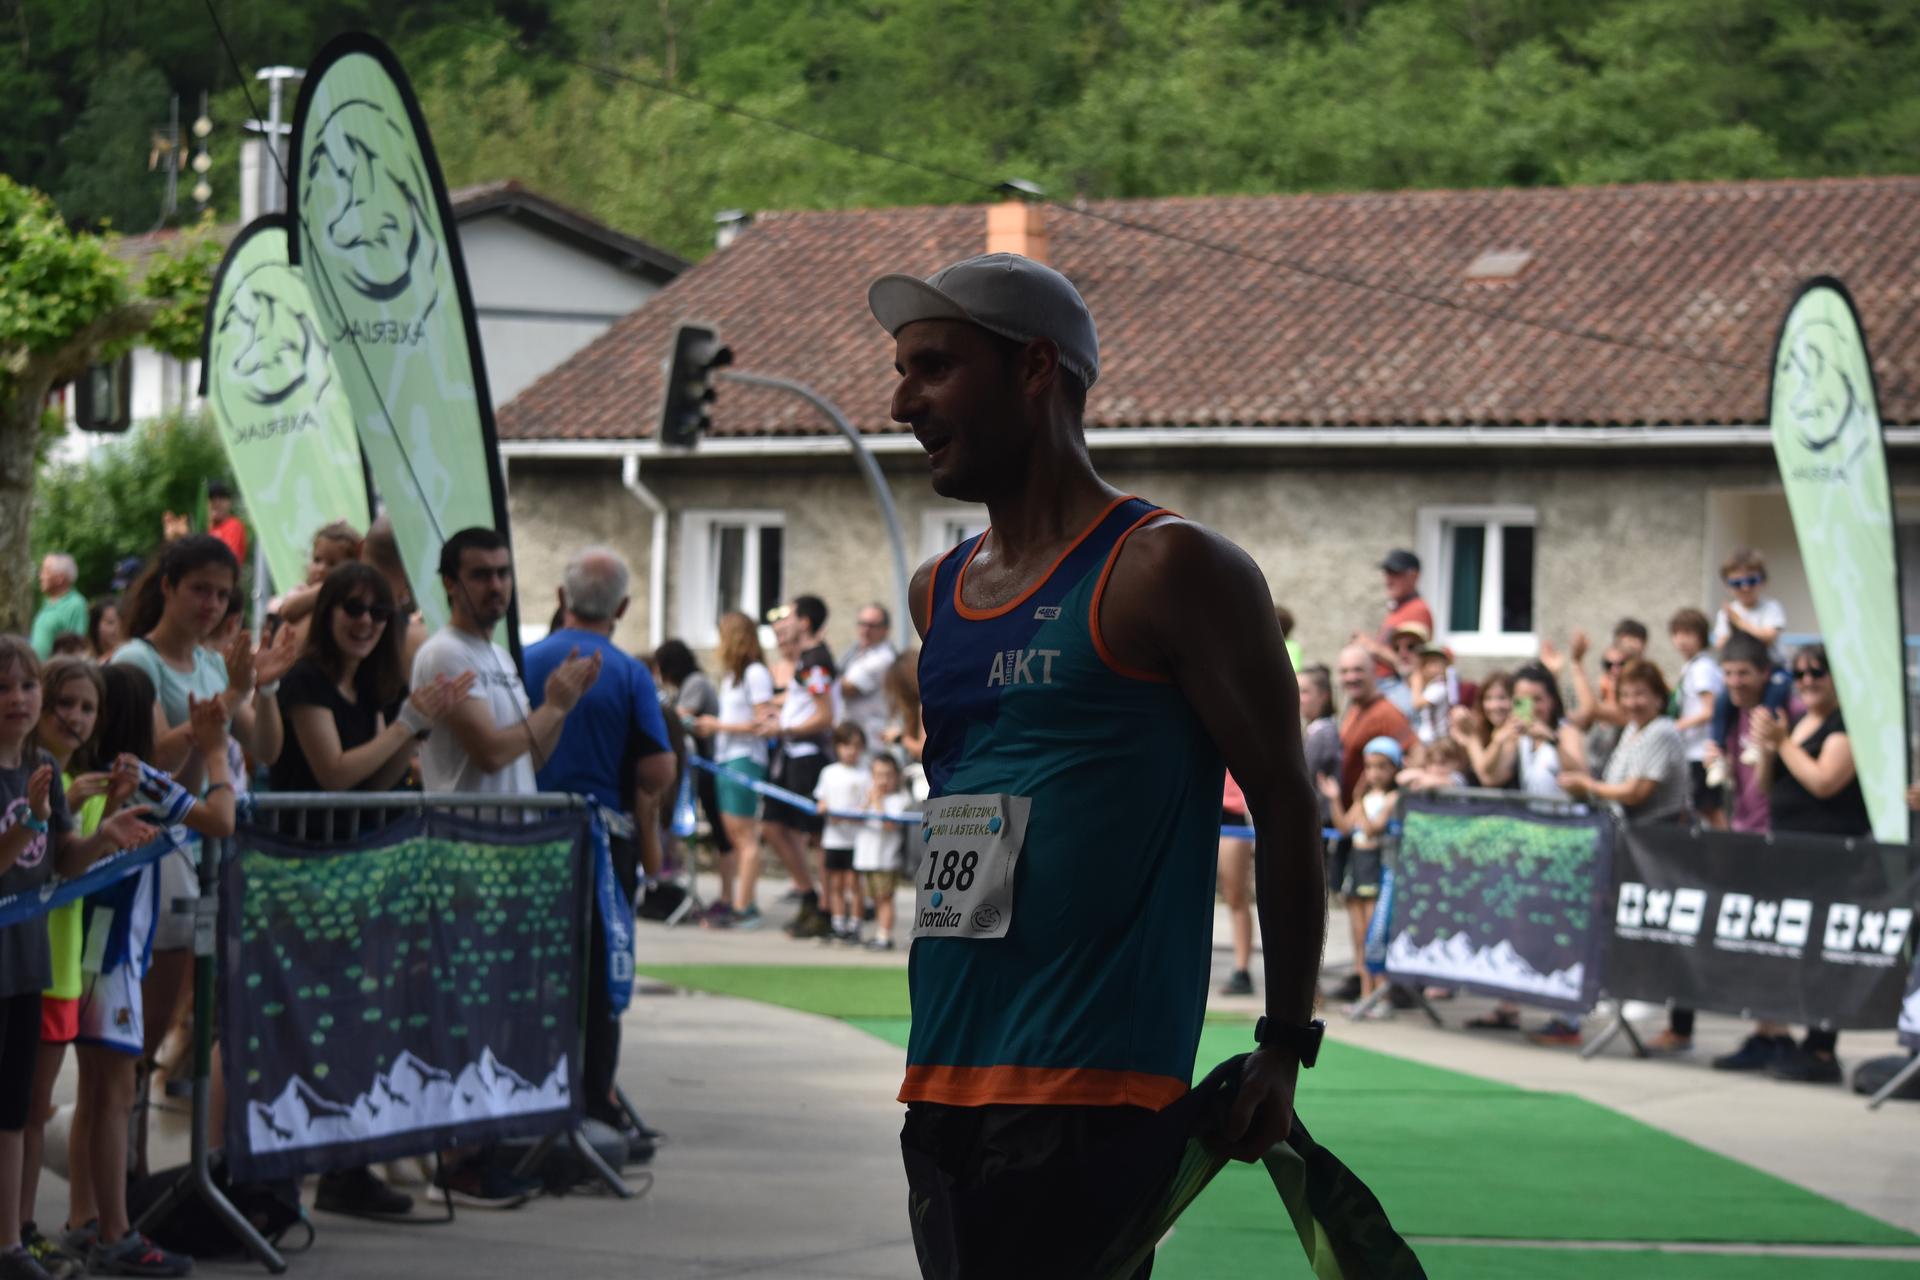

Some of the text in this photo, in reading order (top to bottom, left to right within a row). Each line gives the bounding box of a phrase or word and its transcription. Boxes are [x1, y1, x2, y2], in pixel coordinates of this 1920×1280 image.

[987, 649, 1061, 688] AKT
[931, 823, 996, 837] ENDI LASTERKE
[924, 850, 979, 892] 188
